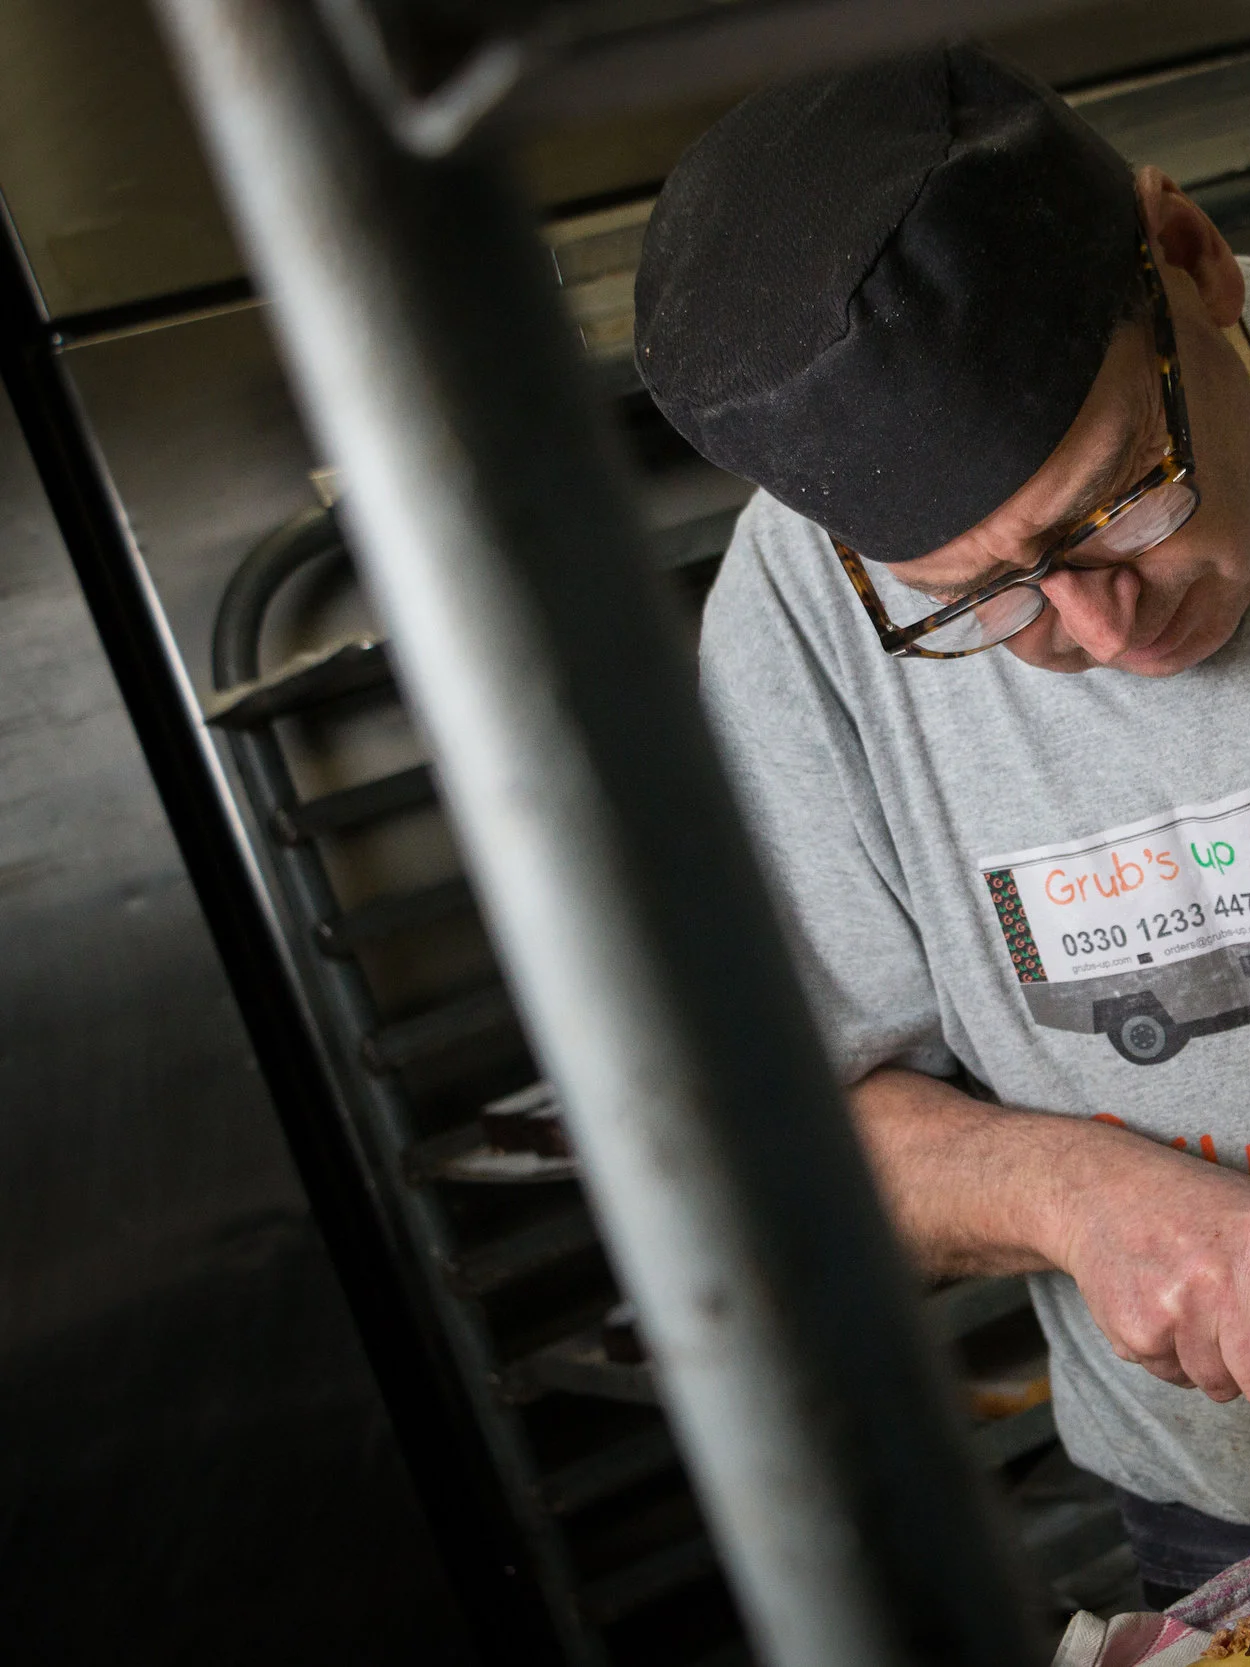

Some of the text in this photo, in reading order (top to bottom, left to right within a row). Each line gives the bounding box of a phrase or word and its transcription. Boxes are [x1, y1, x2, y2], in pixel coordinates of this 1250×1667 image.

[1045, 841, 1235, 905] Grub's up
[1062, 925, 1127, 957] 0330
[1136, 902, 1206, 941] 1233
[1071, 955, 1133, 975] grubs-up.com
